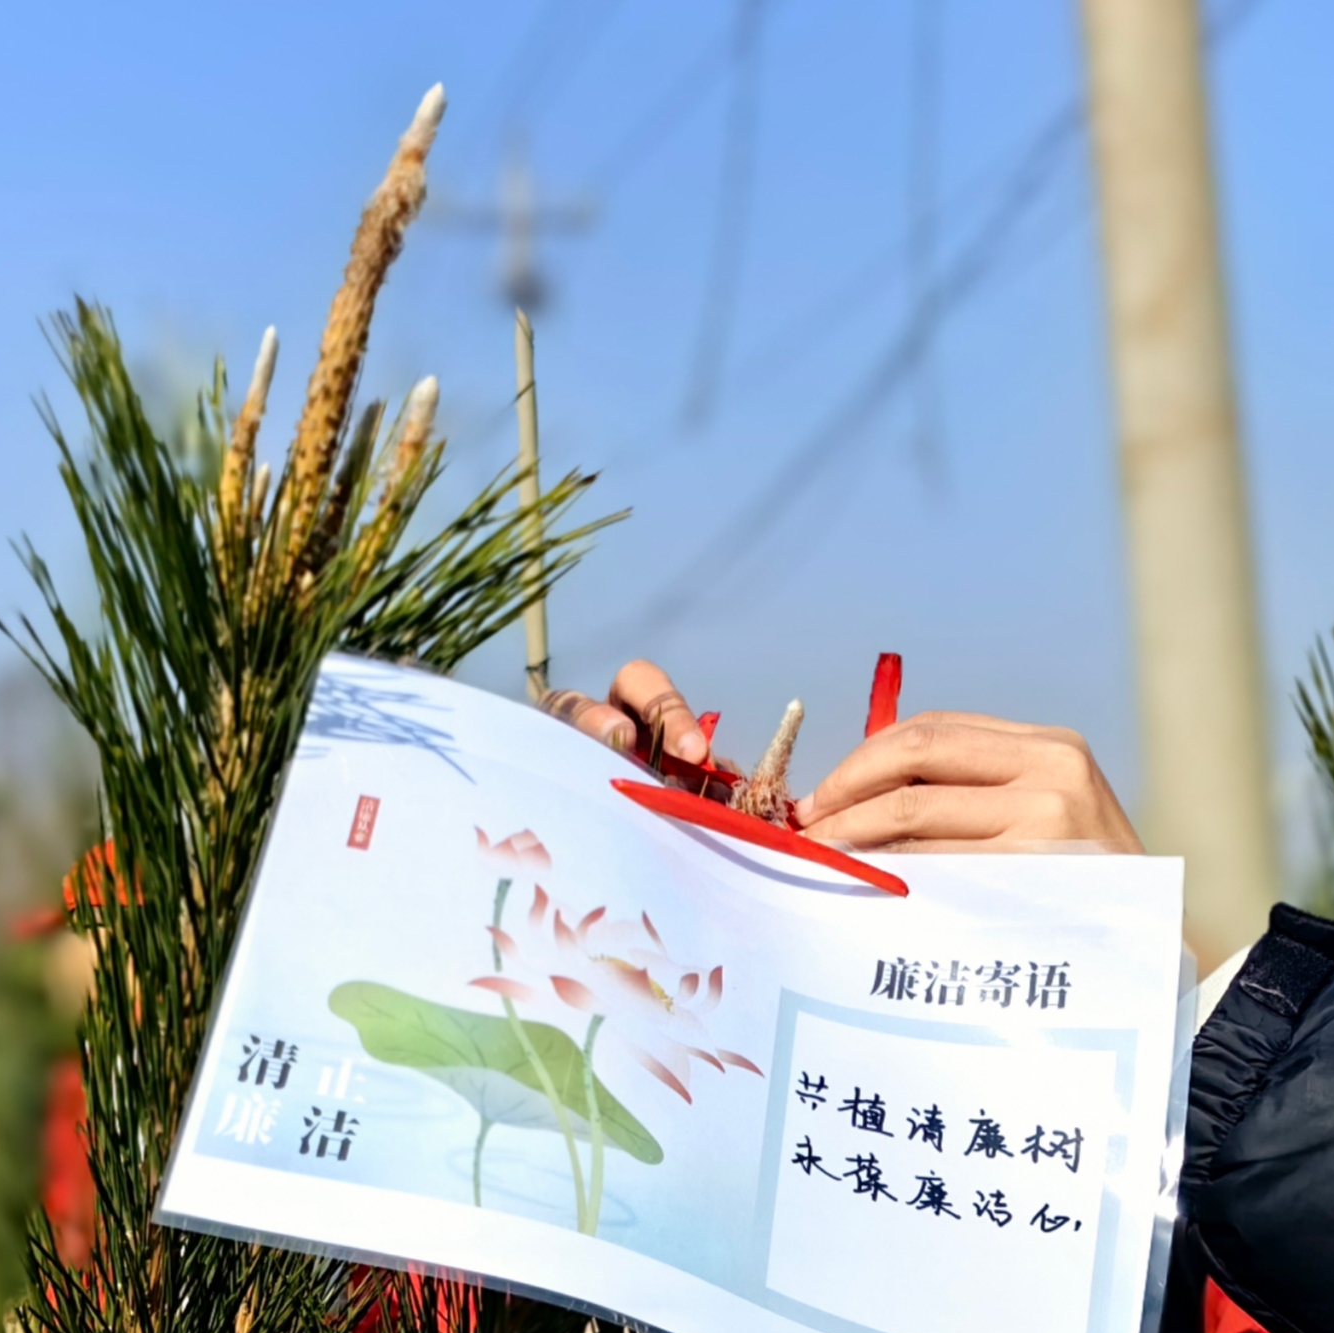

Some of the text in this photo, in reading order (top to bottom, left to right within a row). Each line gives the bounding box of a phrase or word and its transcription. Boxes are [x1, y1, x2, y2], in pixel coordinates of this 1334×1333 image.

[870, 957, 1072, 1009] 廉洁寄语
[795, 1071, 1085, 1174] 共植清廉树
